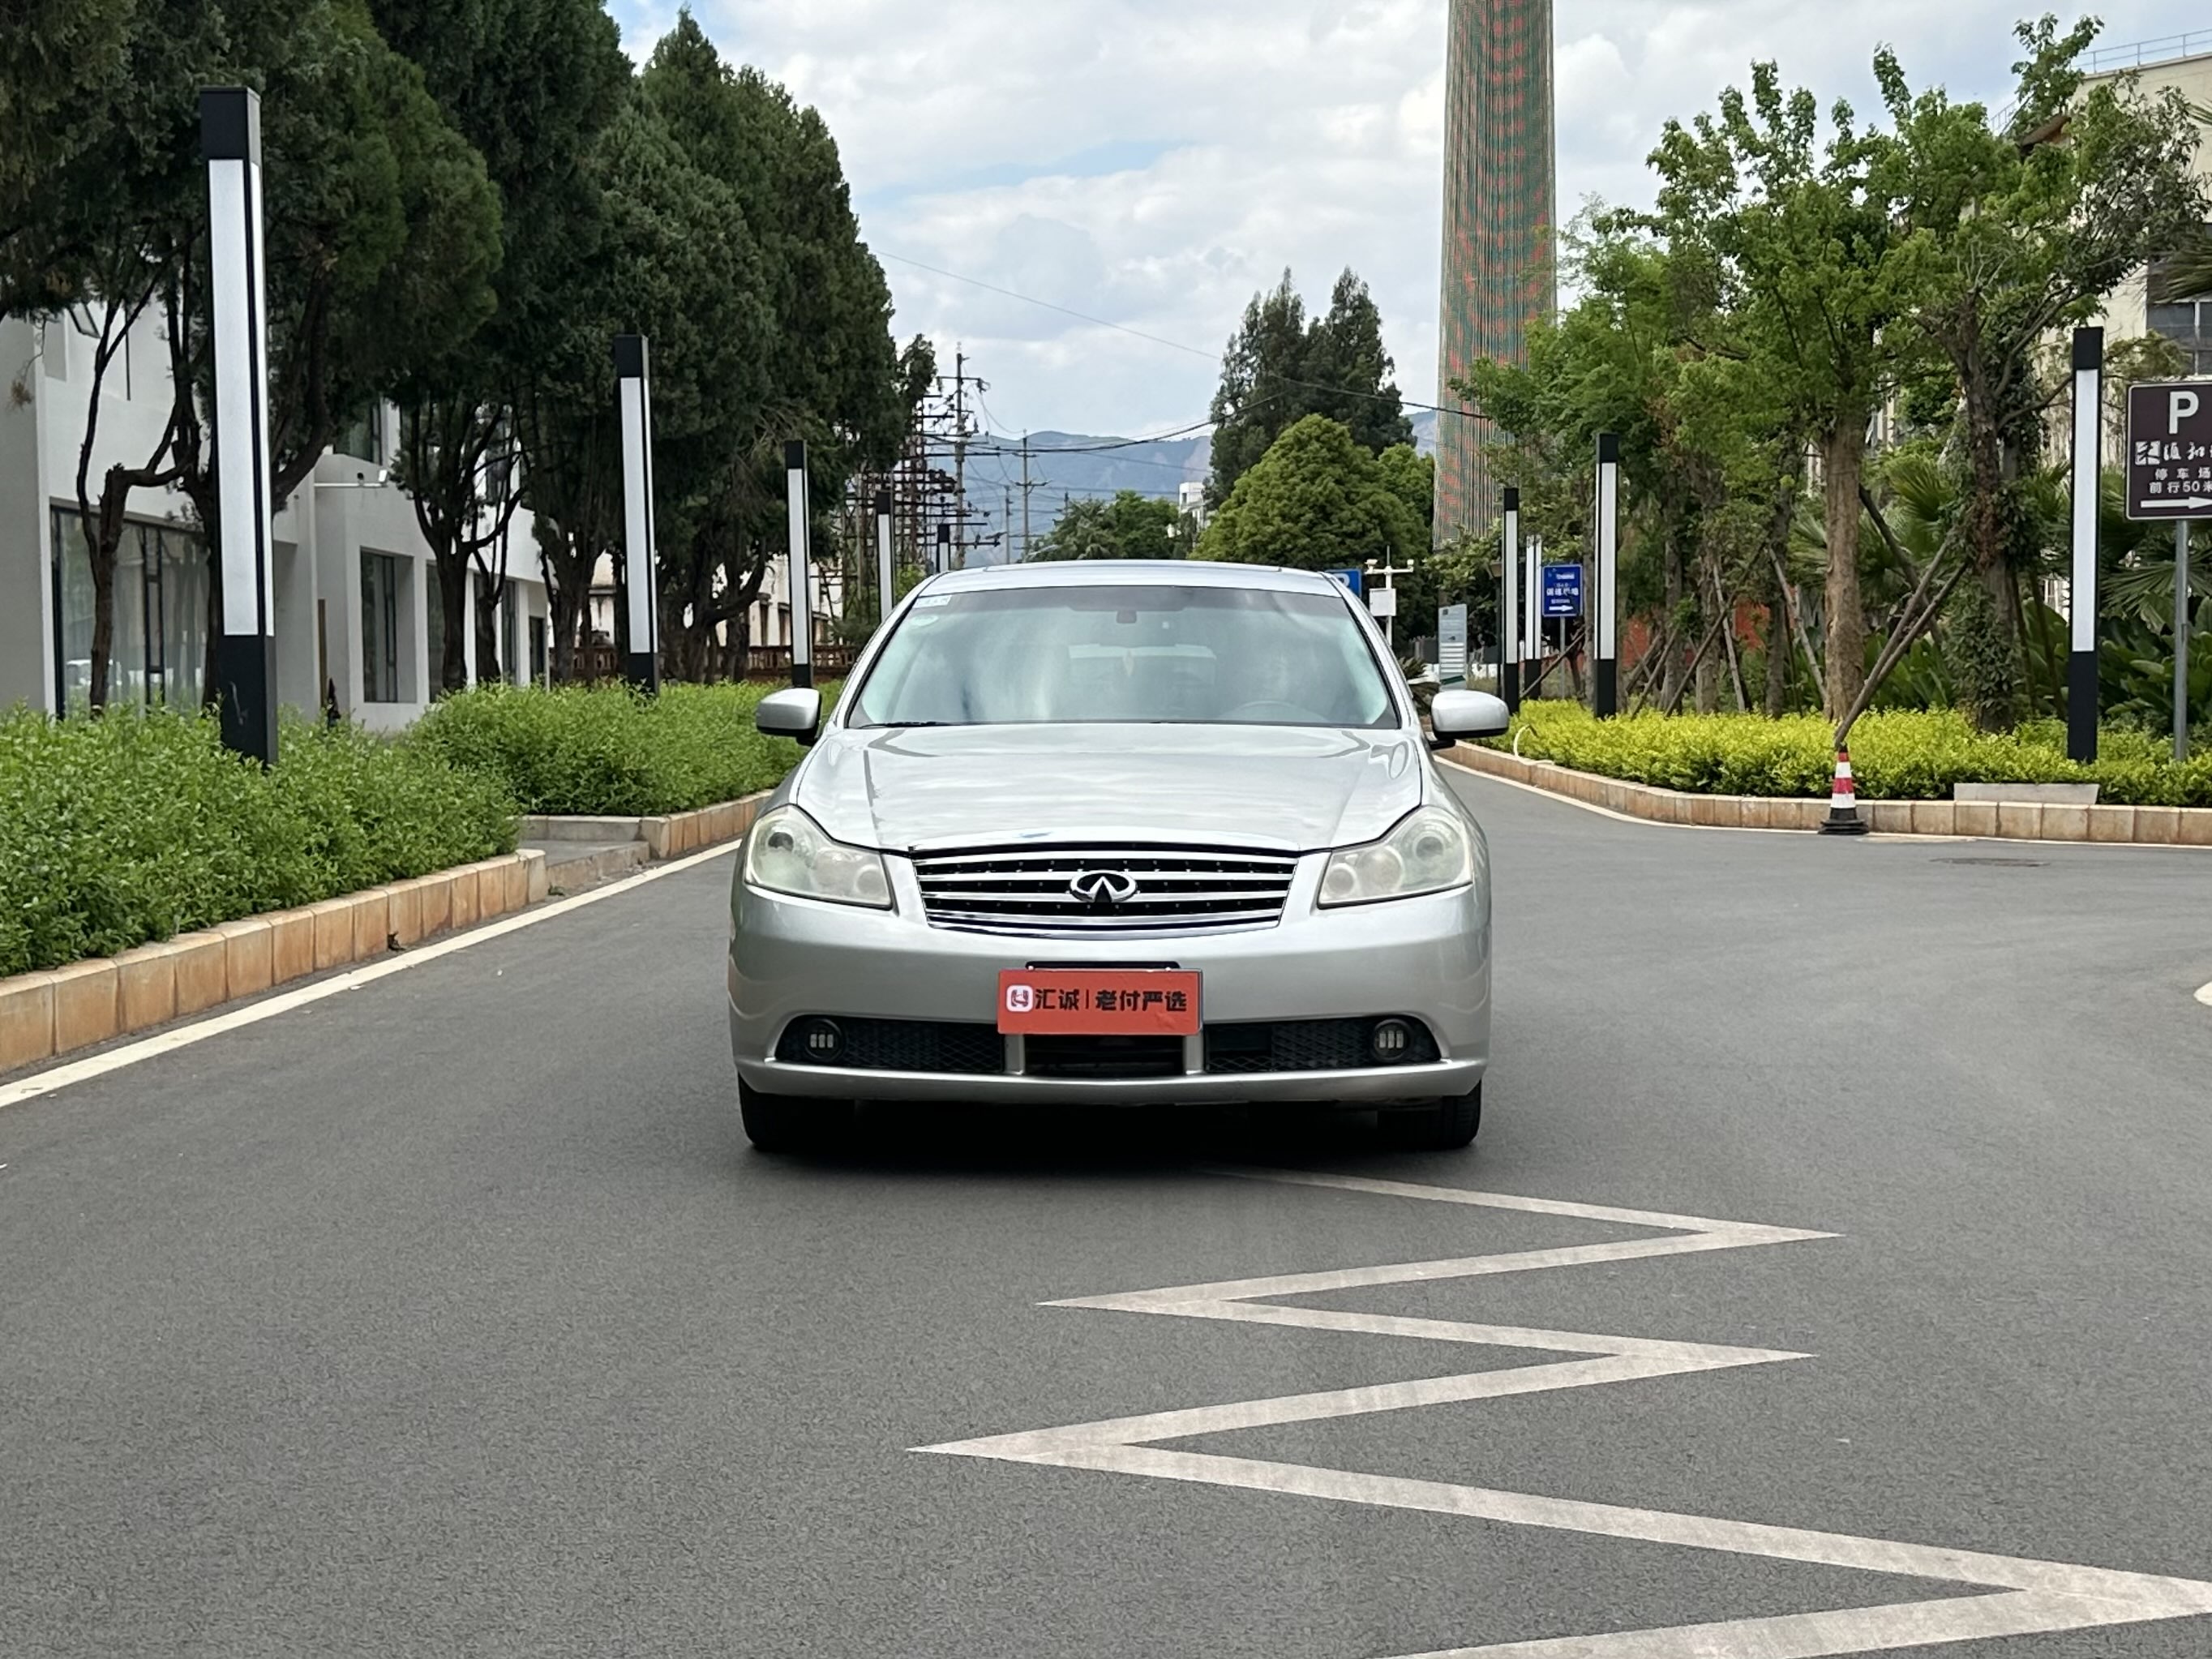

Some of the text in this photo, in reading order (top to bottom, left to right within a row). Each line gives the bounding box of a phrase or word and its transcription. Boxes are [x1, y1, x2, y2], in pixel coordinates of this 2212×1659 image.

[2168, 390, 2199, 435] P
[2154, 466, 2211, 480] 停车场
[1034, 988, 1188, 1012] 汇诚 老付严选
